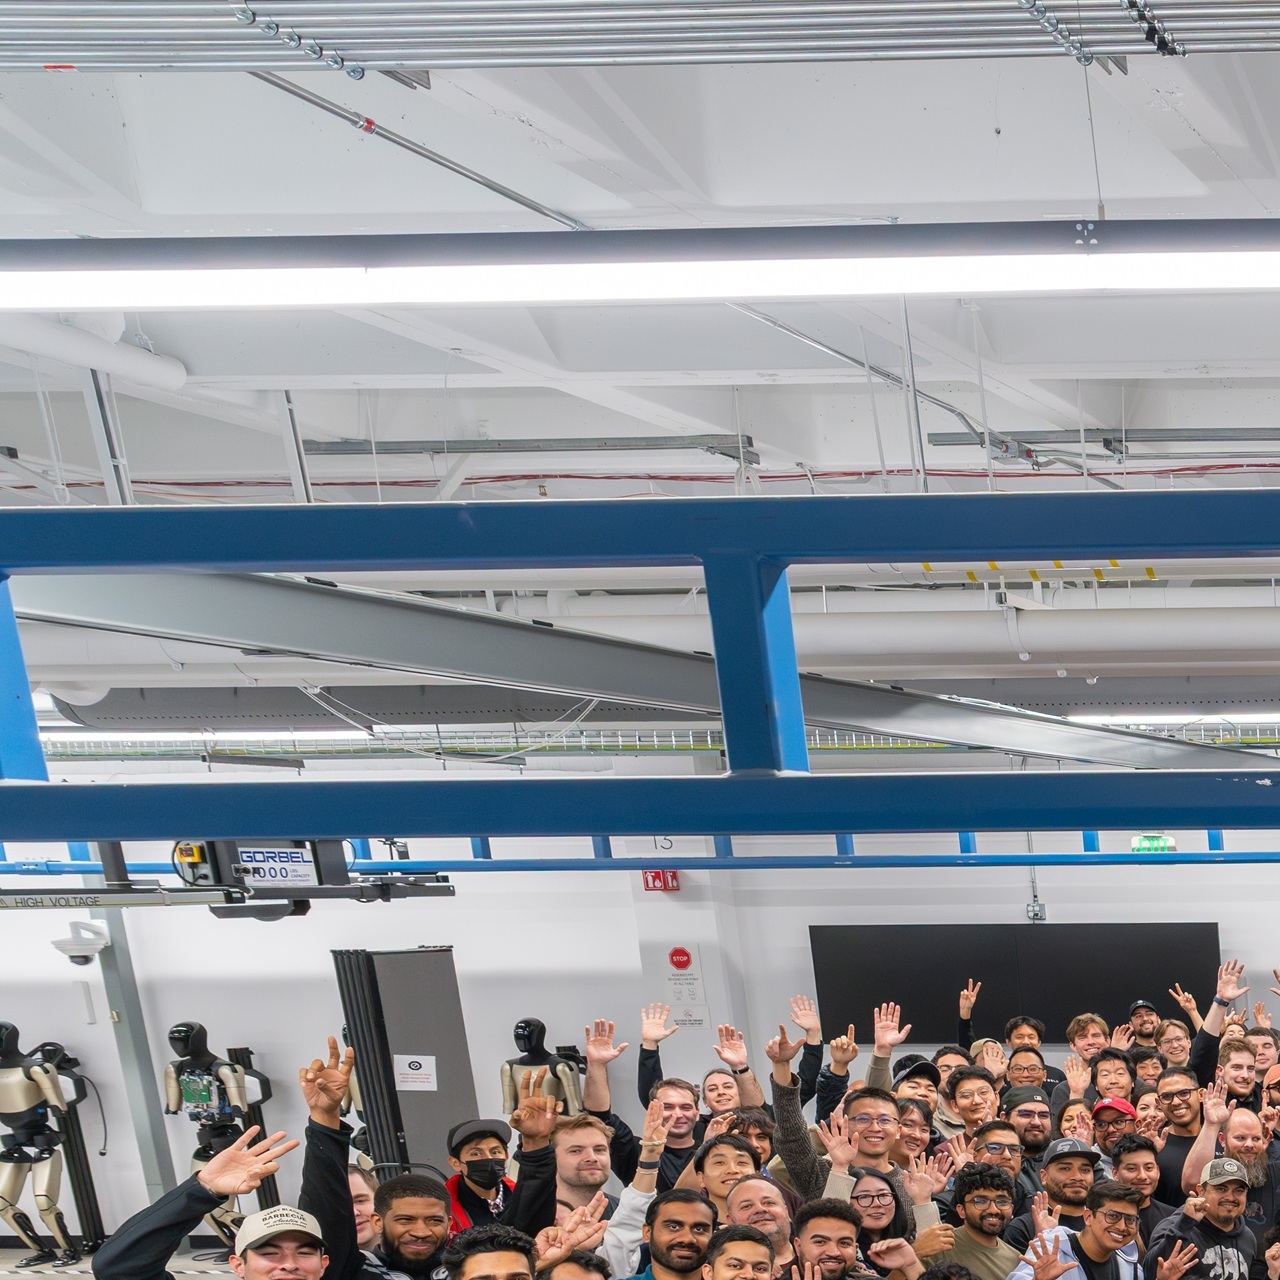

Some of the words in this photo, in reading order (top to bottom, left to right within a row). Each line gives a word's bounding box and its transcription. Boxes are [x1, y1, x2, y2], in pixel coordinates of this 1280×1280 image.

[240, 851, 313, 863] GORBEL
[15, 897, 44, 907] HIGH
[49, 896, 101, 907] VOLTAGE
[262, 1213, 308, 1222] BARBECUE
